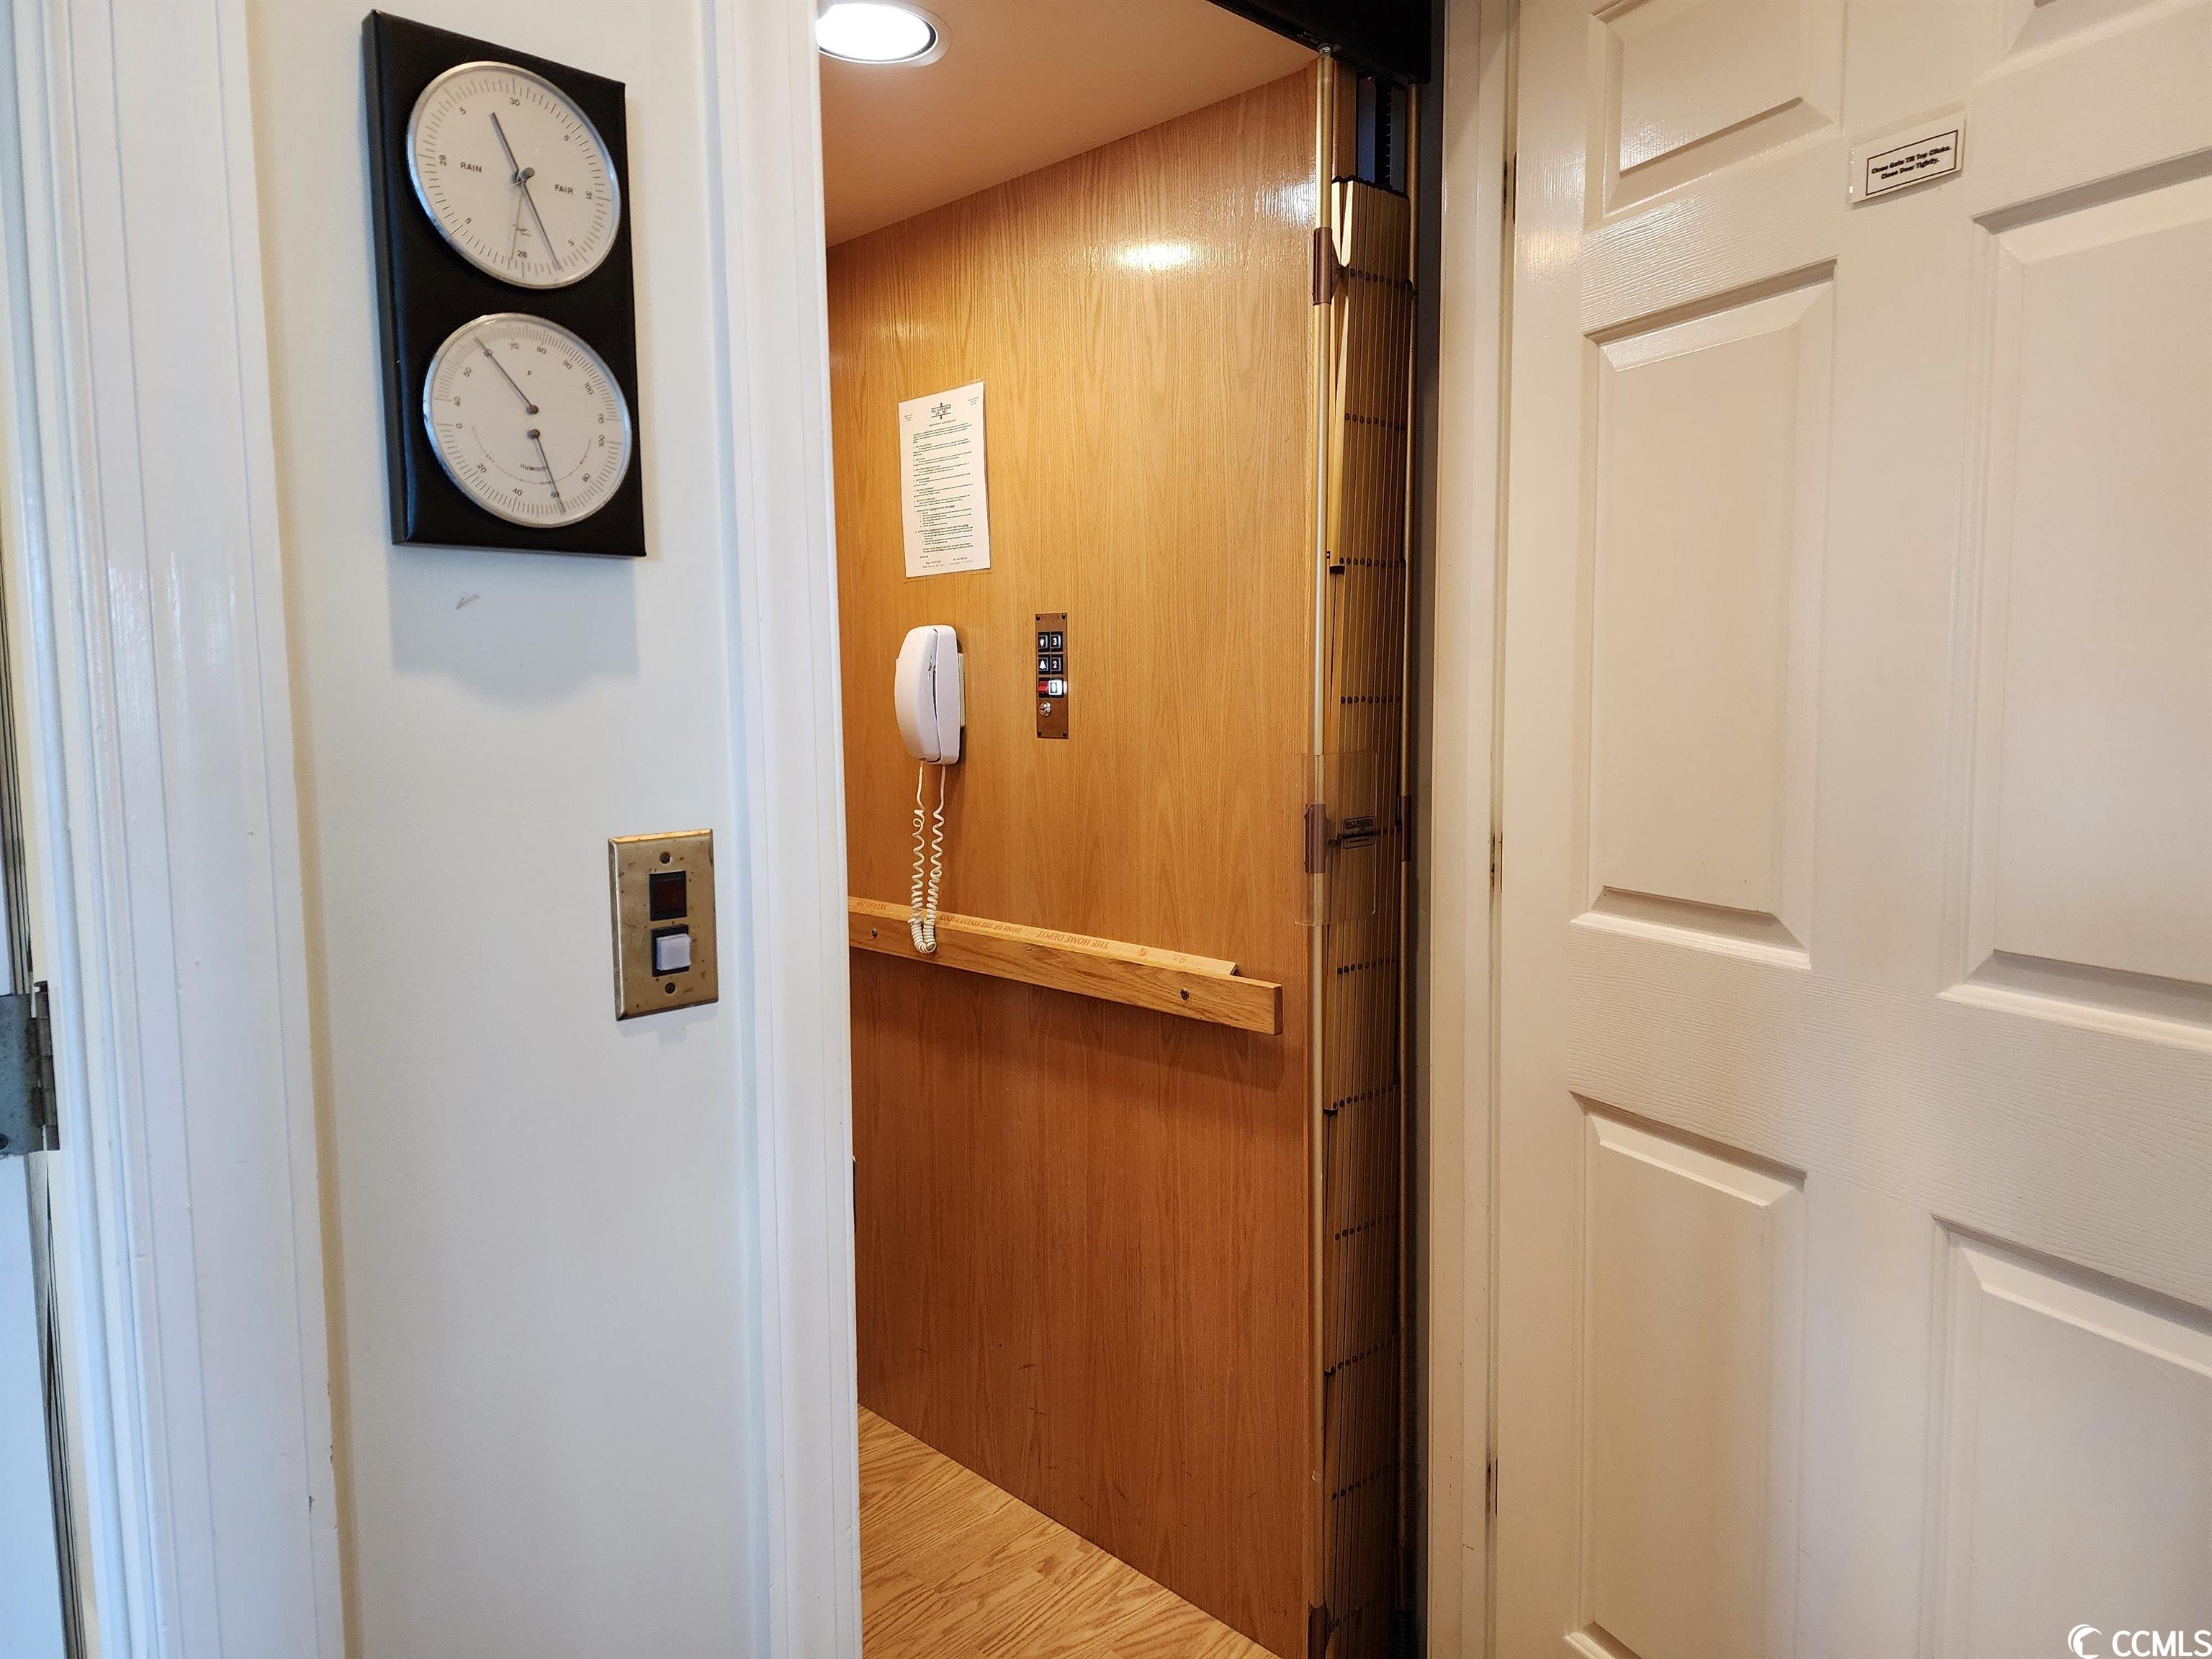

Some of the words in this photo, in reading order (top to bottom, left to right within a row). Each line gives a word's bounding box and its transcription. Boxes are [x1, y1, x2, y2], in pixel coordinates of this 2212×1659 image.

[510, 97, 520, 106] 30
[1889, 160, 1905, 168] Gate
[1929, 145, 1951, 156] Clicks.
[460, 161, 482, 174] RAIN
[1881, 171, 1898, 179] Close
[1899, 166, 1915, 174] Door
[1916, 158, 1939, 168] Tightly.
[554, 184, 573, 195] FAIR
[584, 382, 594, 395] 100
[1038, 930, 1065, 942] DEPOT
[1065, 935, 1092, 946] HOME
[1092, 941, 1110, 950] THE
